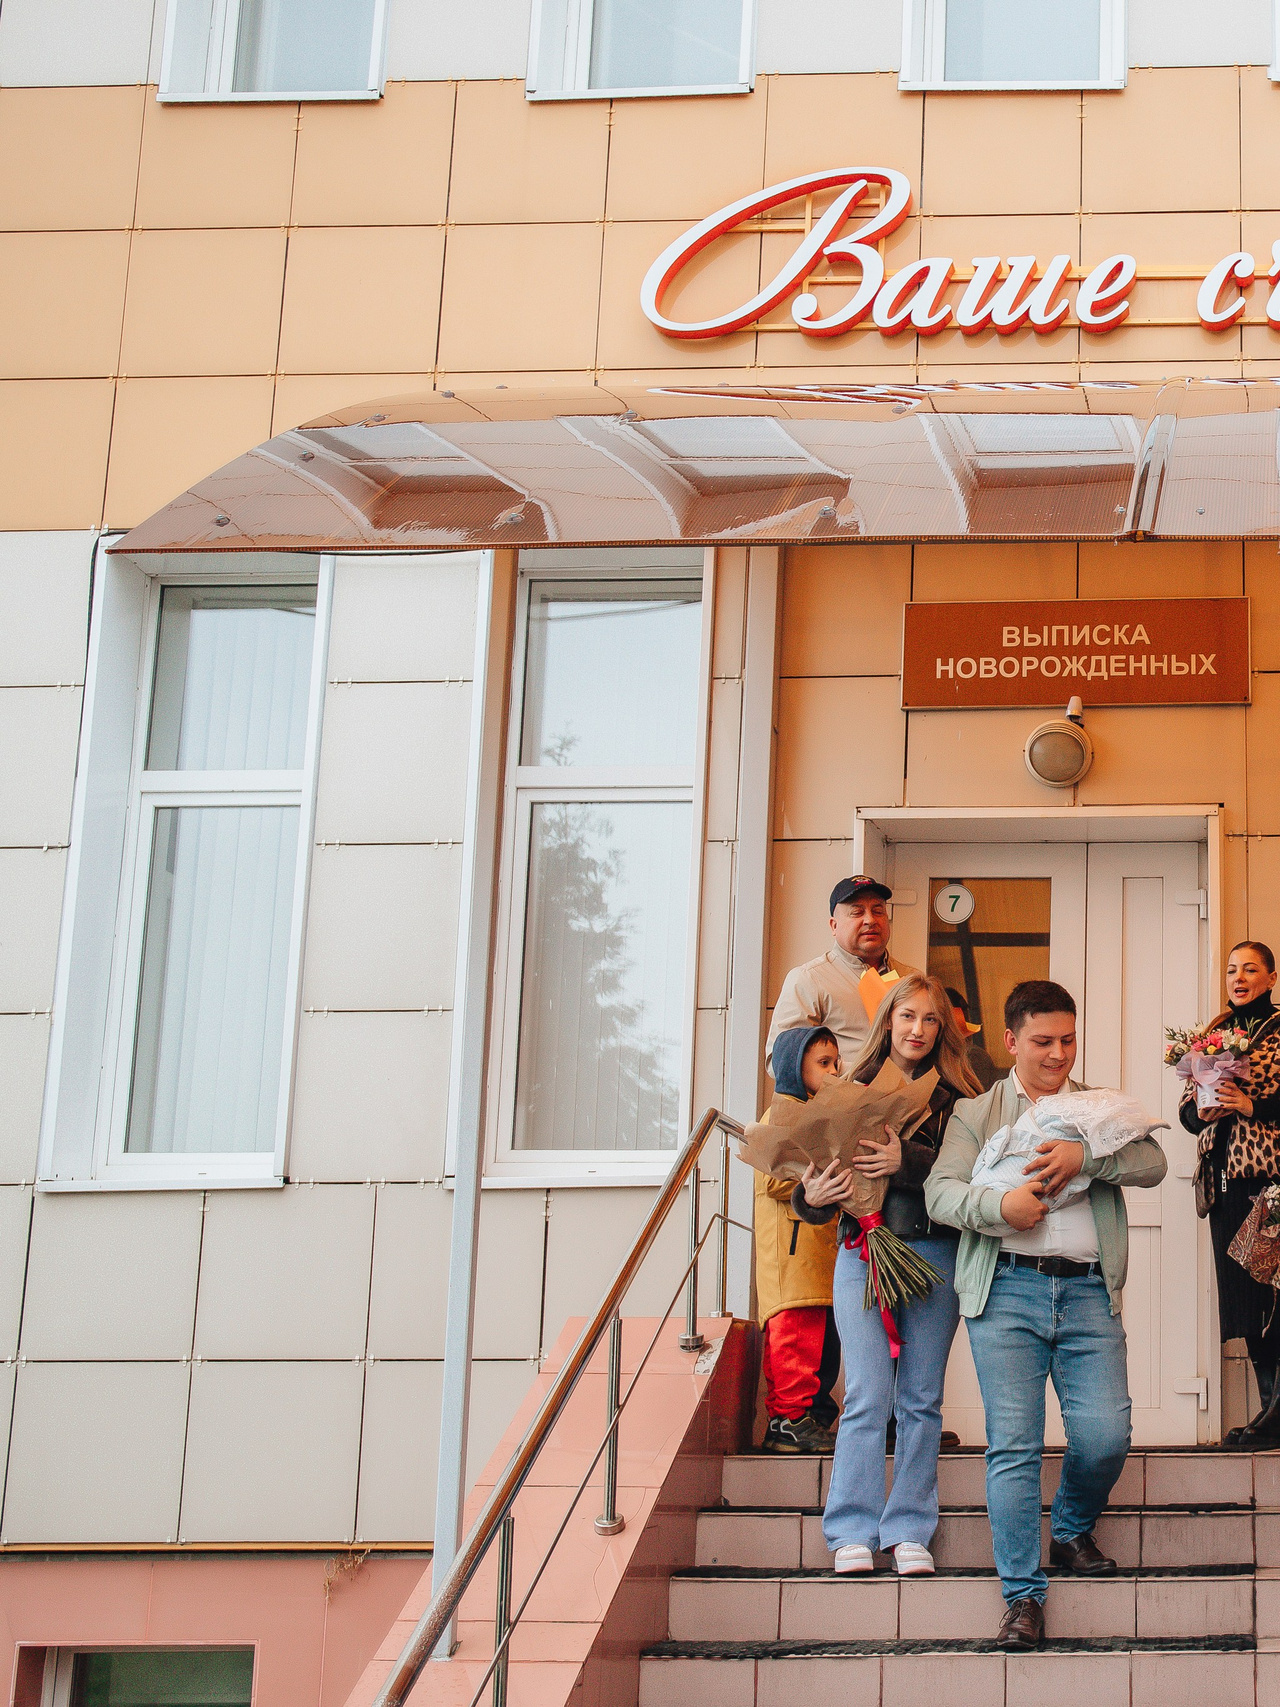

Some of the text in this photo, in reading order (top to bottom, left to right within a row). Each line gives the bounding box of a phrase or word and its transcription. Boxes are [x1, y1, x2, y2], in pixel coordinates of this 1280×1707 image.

[640, 166, 1138, 338] Ваше
[1001, 623, 1151, 648] ВЫПИСКА
[935, 653, 1218, 681] НОВОРОЖДЕННЫХ
[948, 894, 961, 913] 7
